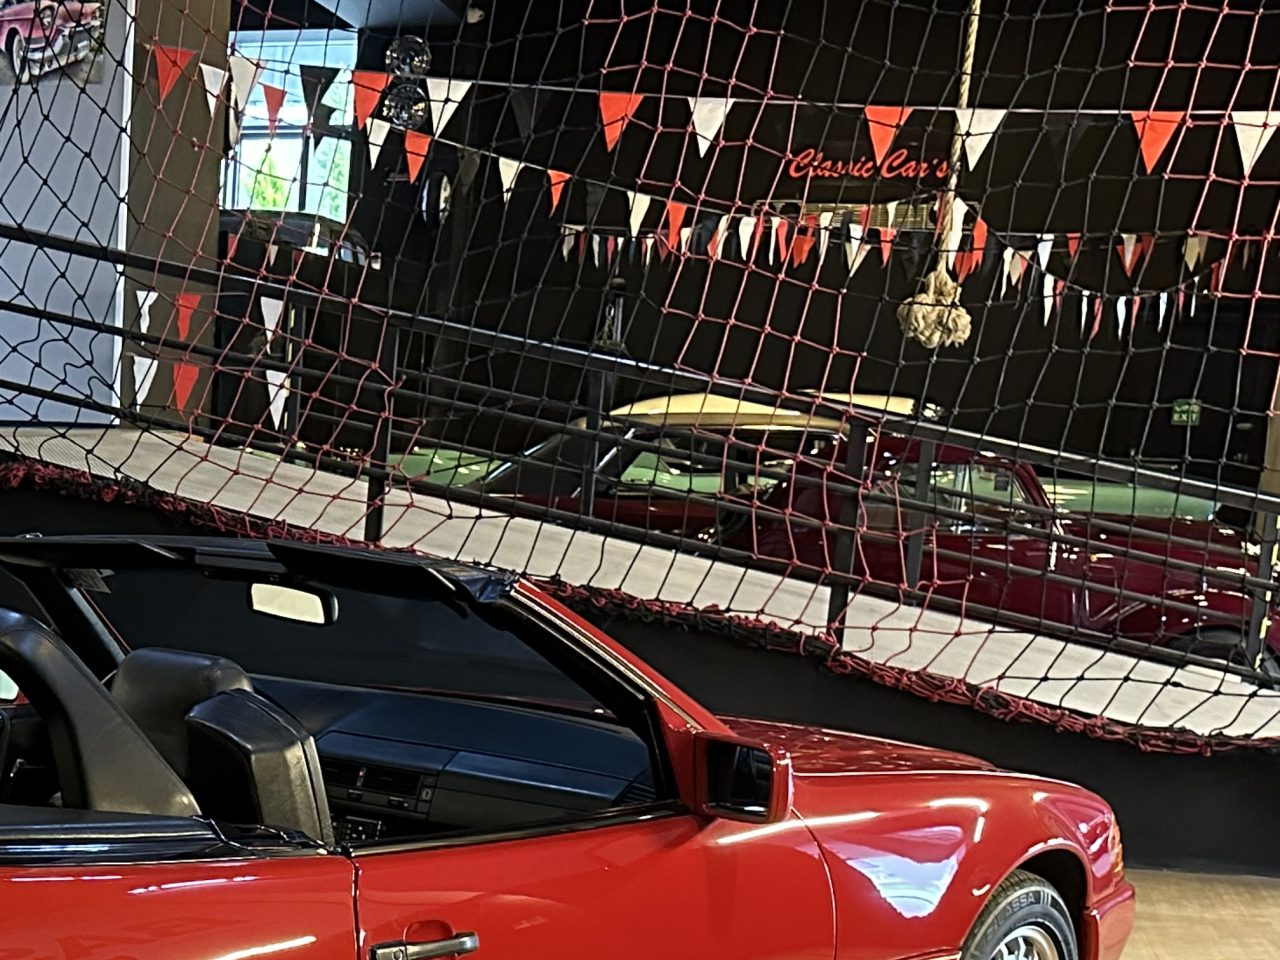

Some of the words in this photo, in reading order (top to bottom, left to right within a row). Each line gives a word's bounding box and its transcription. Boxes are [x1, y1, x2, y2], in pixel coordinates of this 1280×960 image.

[788, 148, 875, 178] Classic
[881, 148, 951, 178] Car's
[1173, 413, 1198, 421] EXT
